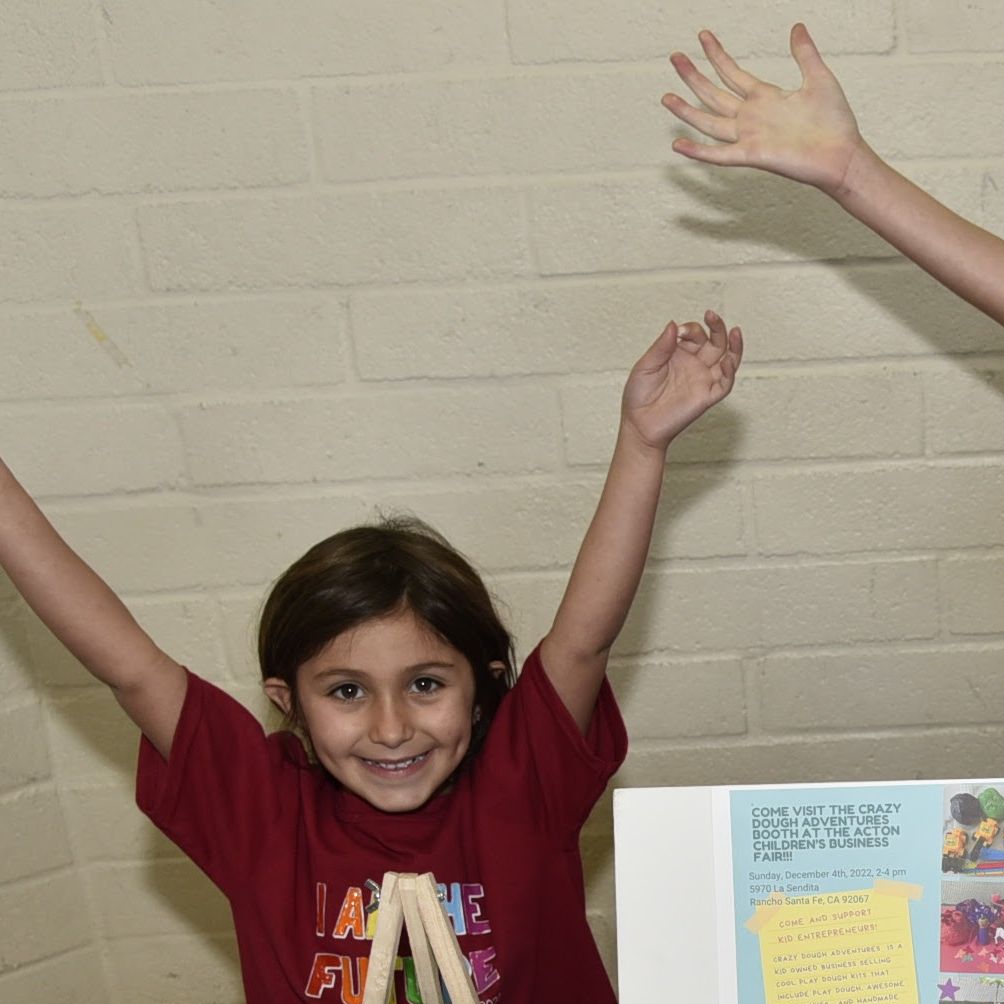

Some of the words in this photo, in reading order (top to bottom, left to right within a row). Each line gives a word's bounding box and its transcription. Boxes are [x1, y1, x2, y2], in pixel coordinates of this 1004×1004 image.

[752, 807, 789, 818] COME
[793, 805, 825, 816] VISIT
[830, 805, 855, 815] THE
[858, 803, 901, 814] CRAZY
[752, 818, 798, 828] DOUGH
[802, 815, 889, 827] ADVENTURES
[753, 829, 798, 839] BOOTH
[802, 828, 821, 838] AT
[824, 828, 850, 837] THE
[854, 826, 900, 836] ACTON
[753, 839, 826, 851] CHILDREN'S
[830, 838, 889, 848] BUSINESS
[754, 852, 792, 862] FAIR!!!
[749, 871, 783, 881] Sunday,
[786, 870, 829, 879] December
[832, 869, 848, 878] 4th,
[850, 869, 874, 878] 2022,
[876, 869, 889, 877] 2-4
[892, 868, 906, 878] pm
[750, 885, 771, 893] 5970
[774, 884, 784, 892] La
[787, 884, 819, 892] Sendita
[750, 897, 782, 906] Rancho
[785, 897, 810, 905] Santa
[813, 896, 825, 905] Fe,
[842, 895, 869, 903] 92067
[316, 883, 326, 937] I
[779, 919, 804, 928] COME
[810, 915, 827, 924] AND
[832, 909, 872, 921] SUPPORT
[778, 935, 792, 944] KID
[798, 924, 877, 942] ENTREPRENEURS!
[773, 955, 797, 963] CRAZY
[802, 951, 827, 960] DOUGH
[831, 946, 880, 956] ADVENTURES
[791, 965, 817, 973] OWNED
[821, 961, 856, 970] BUSINESS
[860, 957, 891, 966] SELLING
[799, 977, 818, 985] PLAY
[822, 973, 847, 983] DOUGH
[778, 991, 809, 1000] INCLUDE
[867, 981, 904, 990] AWESOME
[857, 994, 899, 1004] HANDMADE
